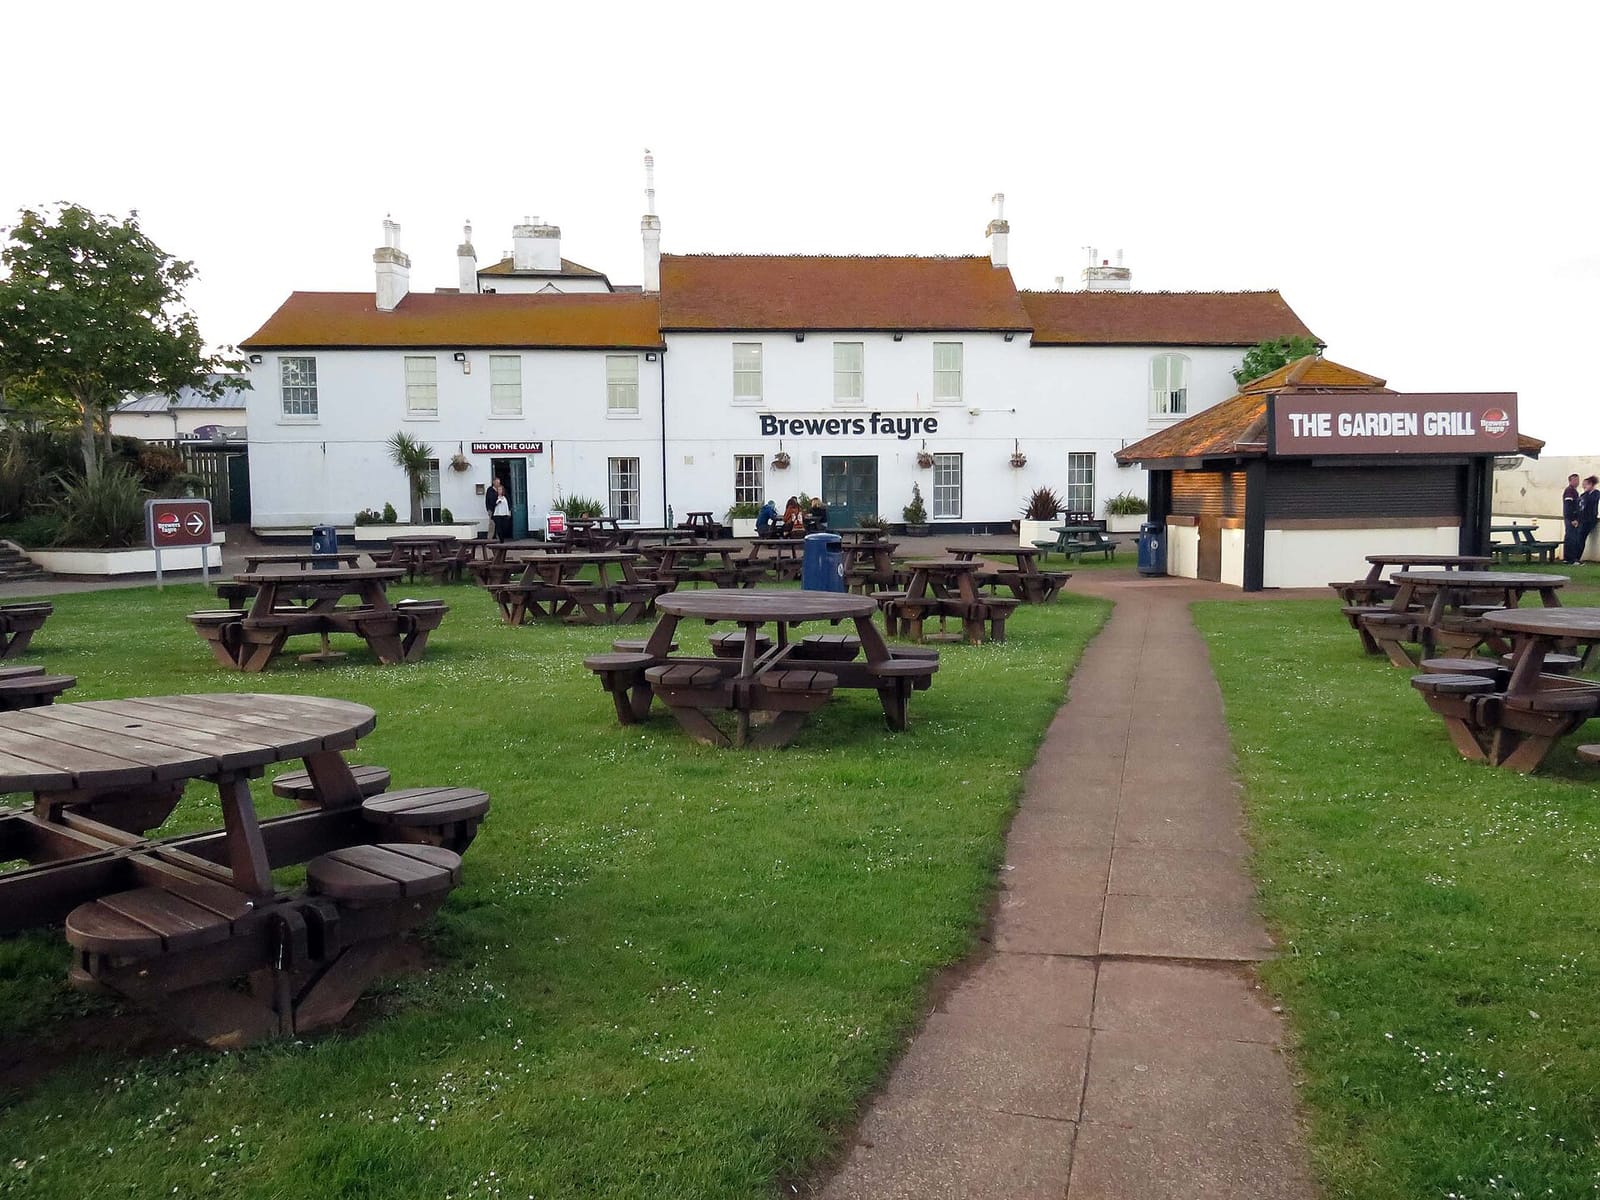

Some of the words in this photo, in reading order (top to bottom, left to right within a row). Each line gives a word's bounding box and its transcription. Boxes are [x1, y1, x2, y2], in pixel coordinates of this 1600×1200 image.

[759, 415, 866, 436] Brewers
[869, 412, 938, 440] fayre
[1288, 413, 1332, 437] THE
[1338, 412, 1418, 437] GARDEN
[1423, 412, 1476, 436] GRILL
